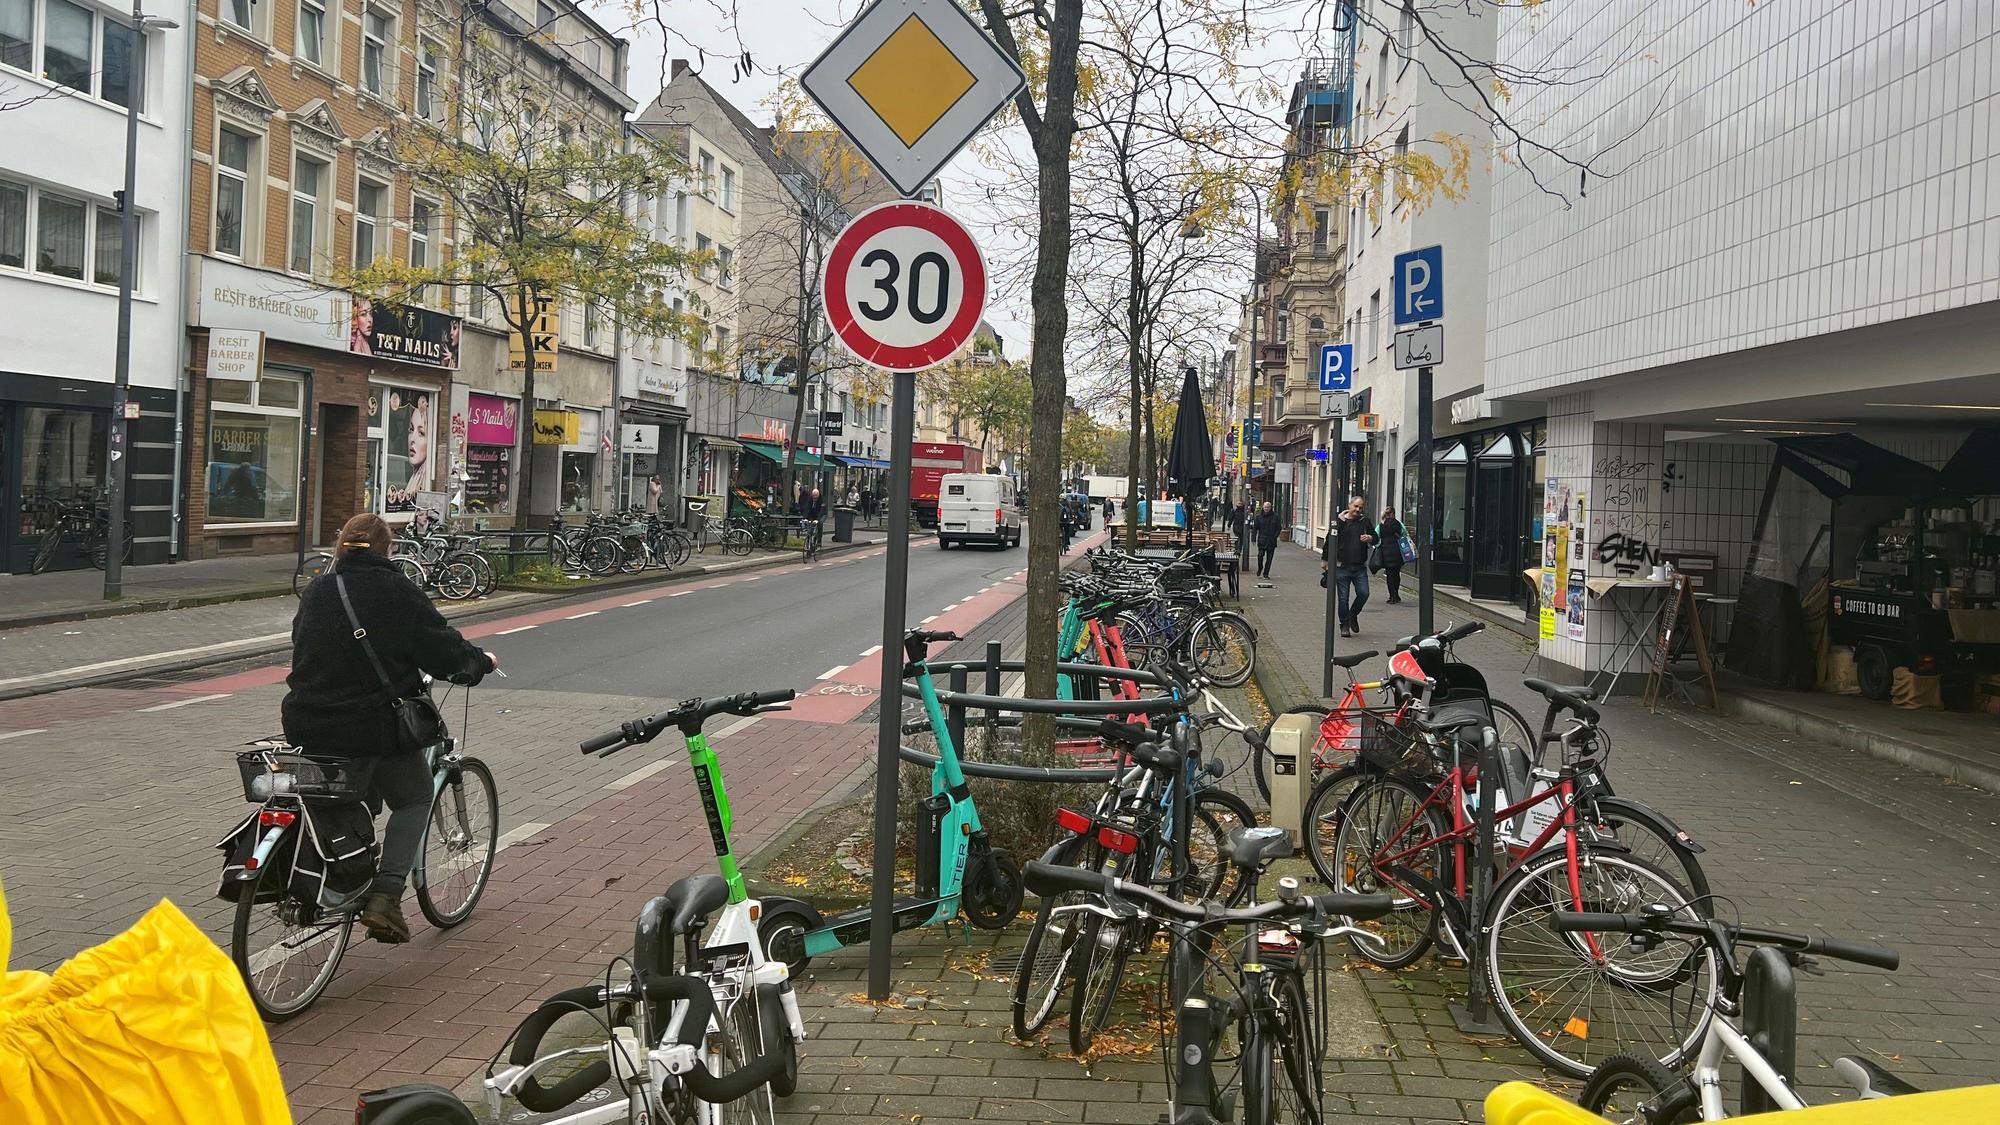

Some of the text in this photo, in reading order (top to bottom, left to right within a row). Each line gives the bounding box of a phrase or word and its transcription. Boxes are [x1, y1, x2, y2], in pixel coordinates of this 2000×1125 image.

[858, 249, 949, 324] 30
[1405, 259, 1431, 315] P
[249, 294, 292, 317] BARBER
[294, 304, 319, 321] SHOP
[210, 349, 255, 361] BARBER
[376, 332, 402, 351] T&T
[404, 337, 440, 359] NAILS
[217, 362, 246, 373] SHOP
[1325, 351, 1343, 385] P
[482, 409, 504, 426] Nails
[213, 429, 262, 447] BARBER
[1597, 532, 1661, 567] SHEN
[1845, 599, 1900, 618] COFFEE TO GO BAR
[952, 842, 967, 886] TIER
